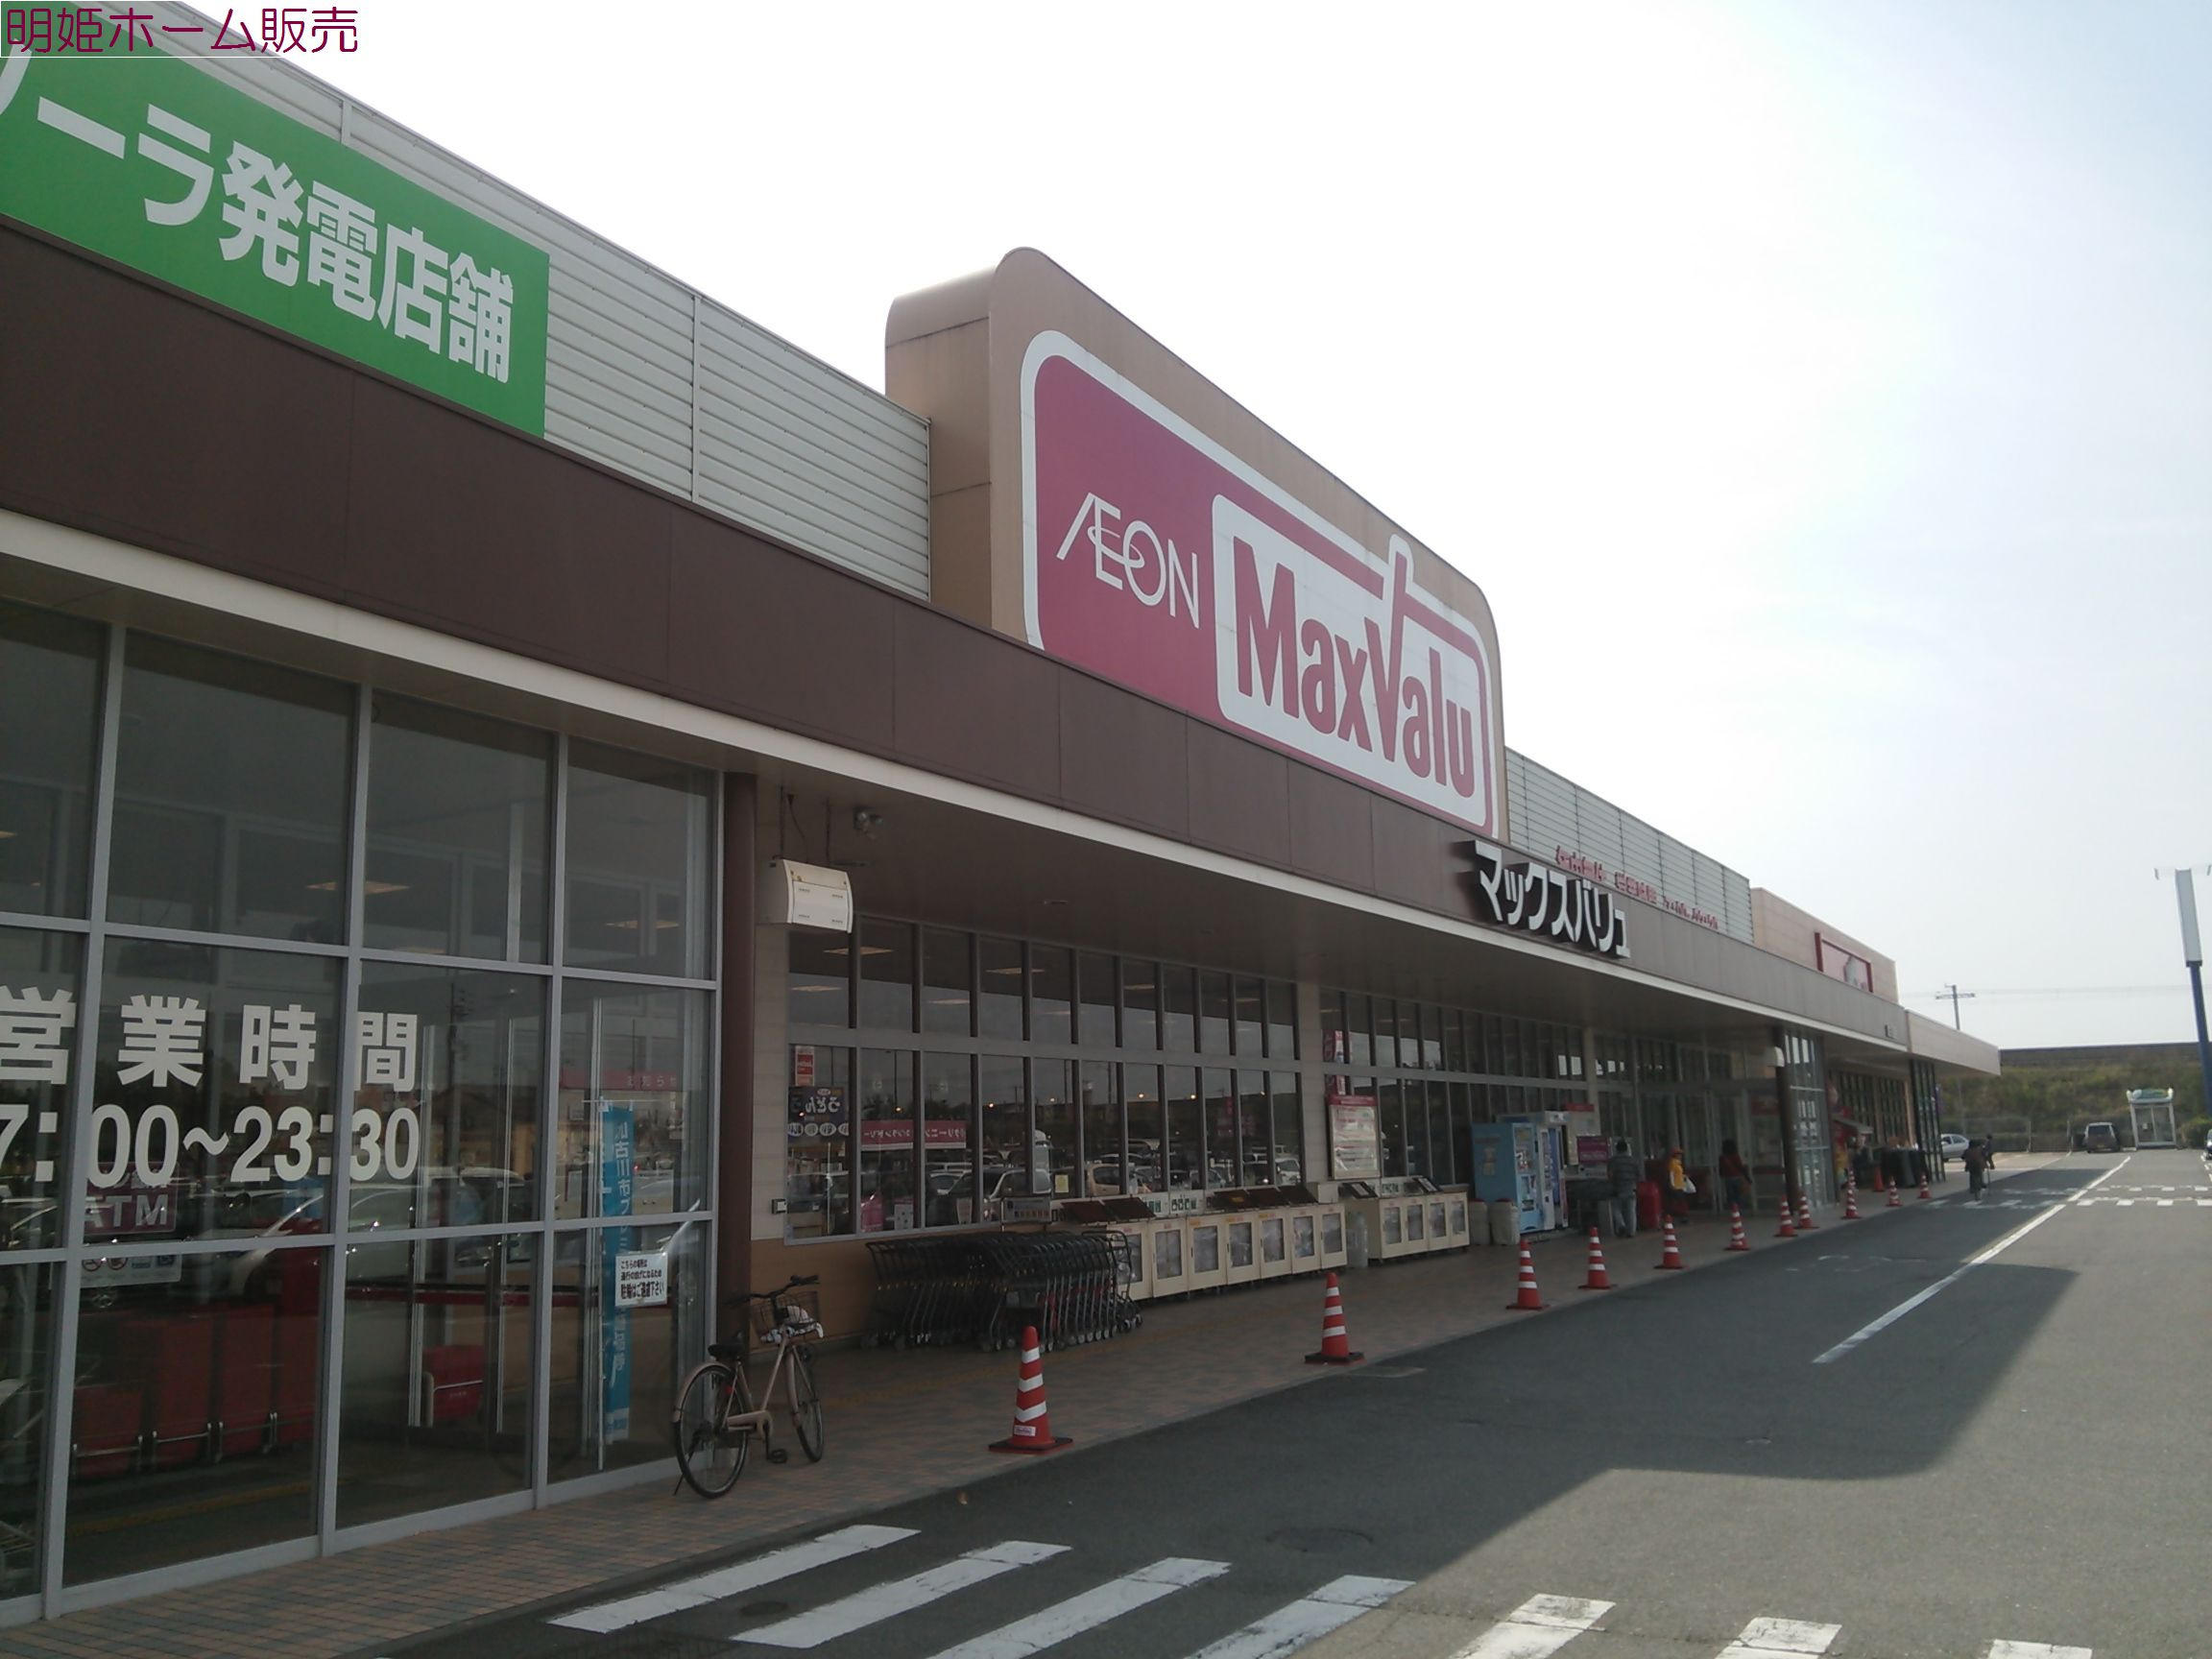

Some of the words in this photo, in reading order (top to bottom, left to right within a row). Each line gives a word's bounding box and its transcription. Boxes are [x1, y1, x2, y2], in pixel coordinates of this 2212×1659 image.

[1233, 550, 1477, 798] MaxValu
[1475, 839, 1630, 958] マックスバリュ
[0, 985, 419, 1093] 営業時間
